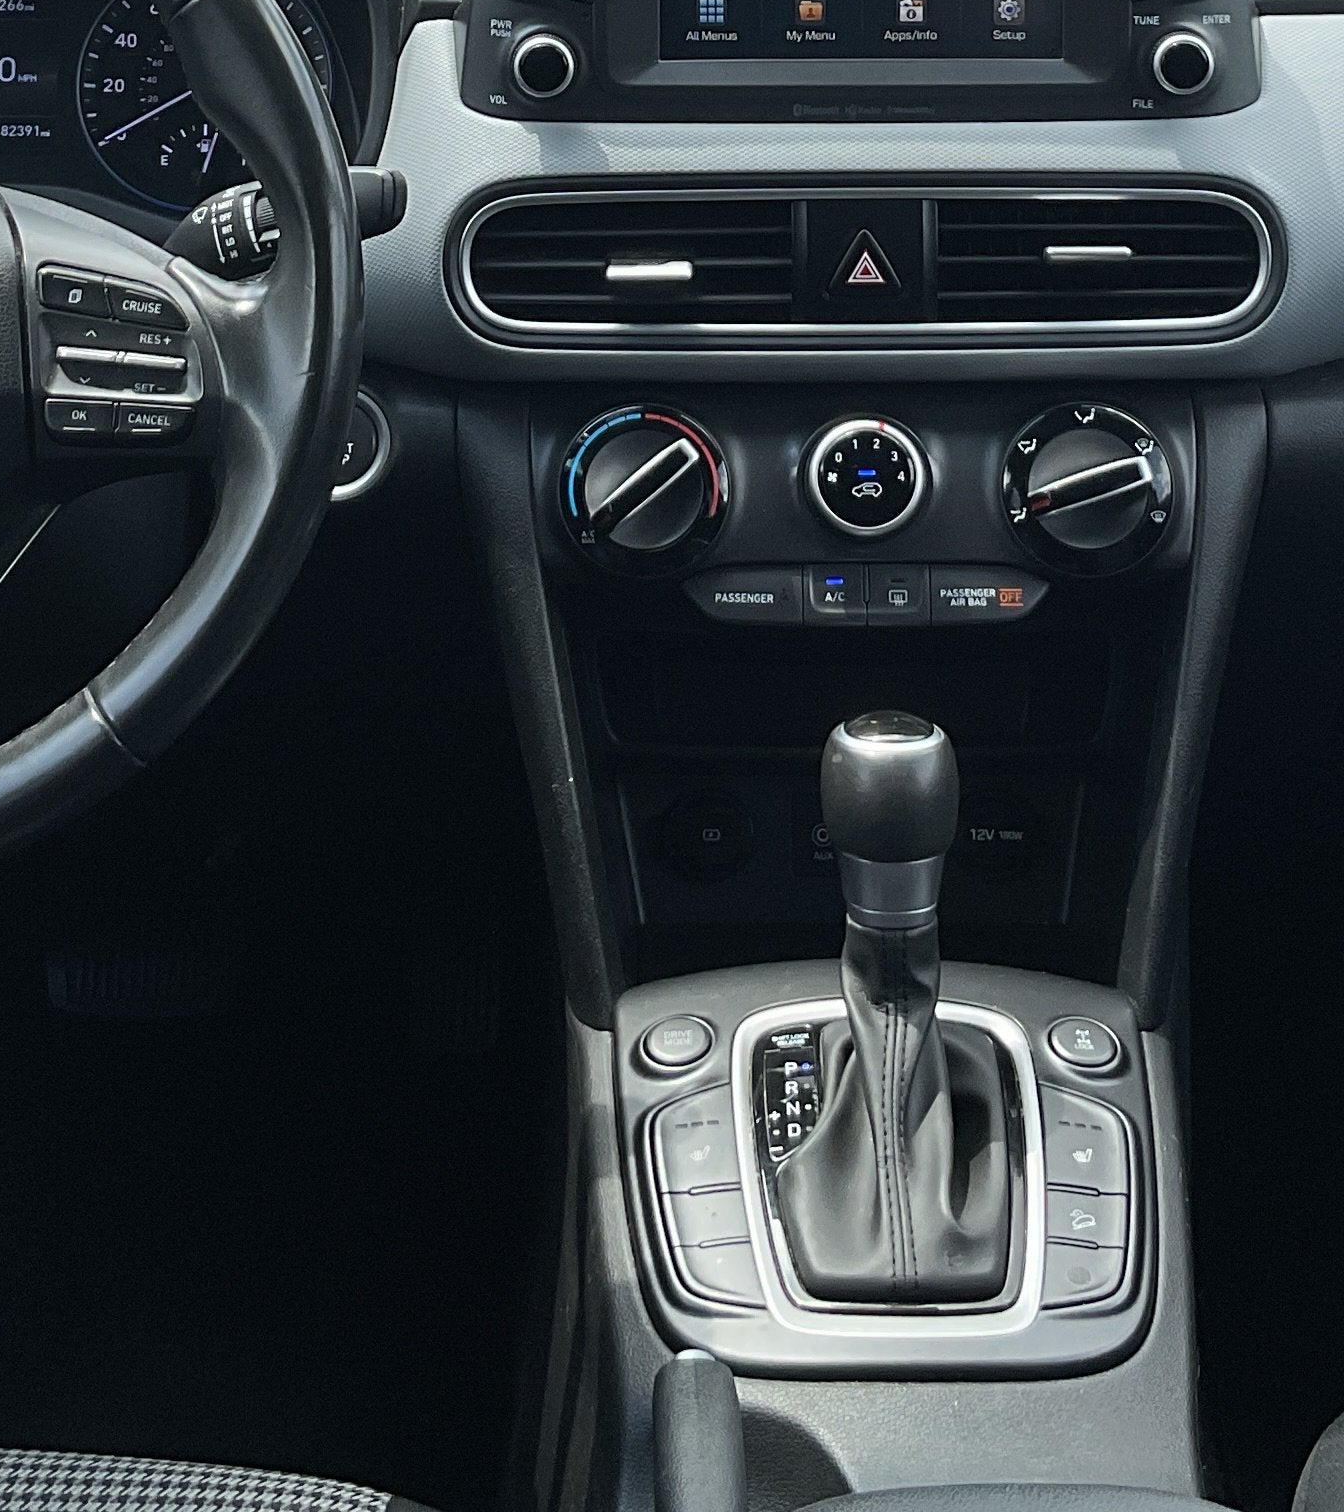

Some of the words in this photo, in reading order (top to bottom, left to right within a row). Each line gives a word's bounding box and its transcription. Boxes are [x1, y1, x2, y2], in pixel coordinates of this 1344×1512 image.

[490, 19, 513, 29] PWR
[1133, 16, 1160, 25] TUNE
[1202, 14, 1231, 24] ENTER
[490, 29, 511, 38] PUSH
[685, 31, 700, 41] All
[701, 31, 738, 41] Menus
[786, 31, 803, 43] My
[804, 31, 836, 41] Menu
[884, 30, 938, 42] Apps/Info
[992, 30, 1026, 42] Setup
[114, 33, 138, 48] 40
[18, 74, 37, 82] MPH
[103, 78, 125, 93] 20
[489, 95, 508, 105] VOL
[1132, 99, 1154, 109] FILE
[160, 154, 169, 166] E
[122, 299, 162, 315] CRUISE
[139, 333, 161, 344] RES
[134, 383, 154, 393] SET
[71, 410, 87, 421] OK
[128, 413, 171, 427] CANCEL
[852, 438, 858, 449] 1
[873, 438, 880, 449] 2
[835, 452, 843, 463] 0
[891, 451, 898, 461] 3
[897, 470, 905, 481] 4
[715, 593, 774, 603] PASSENGER
[825, 592, 845, 602] A/C
[940, 589, 996, 598] PASSENGER
[999, 591, 1023, 603] OFF
[950, 598, 965, 606] AIR
[967, 598, 987, 607] BAG
[970, 829, 995, 841] 12V
[664, 1030, 692, 1039] DRIVE
[664, 1038, 691, 1046] MODE
[784, 1062, 798, 1076] P
[785, 1080, 798, 1095] R
[786, 1101, 801, 1115] N
[787, 1123, 801, 1137] D
